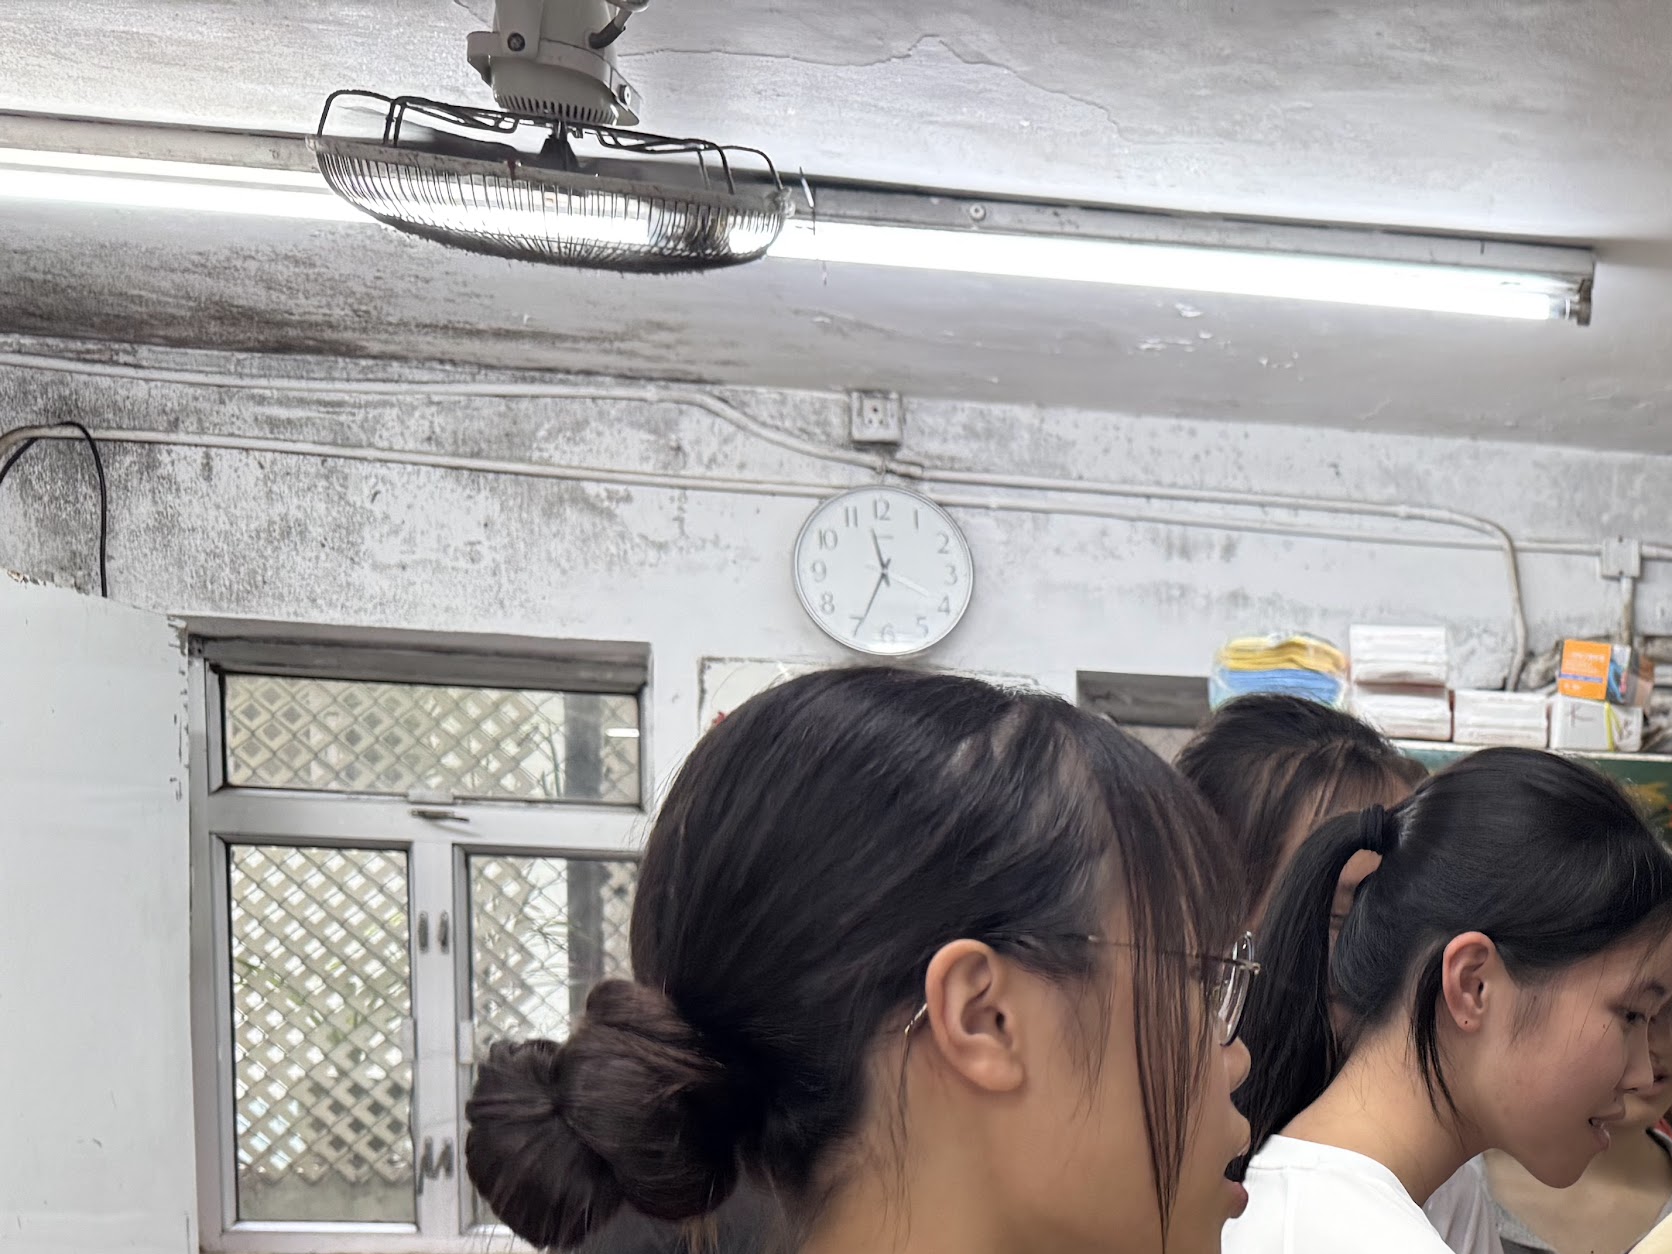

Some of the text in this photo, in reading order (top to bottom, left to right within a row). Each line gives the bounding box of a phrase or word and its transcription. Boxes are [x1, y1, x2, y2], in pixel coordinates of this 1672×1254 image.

[845, 506, 858, 528] 11
[873, 499, 890, 521] 12
[913, 509, 919, 530] 1
[818, 529, 838, 550] 10
[937, 534, 949, 554] 2
[811, 560, 827, 582] 9
[944, 565, 958, 585] 3
[821, 592, 835, 615] 8
[937, 595, 950, 616] 4
[850, 616, 864, 637] 7
[881, 623, 895, 644] 6
[915, 616, 929, 637] 5
